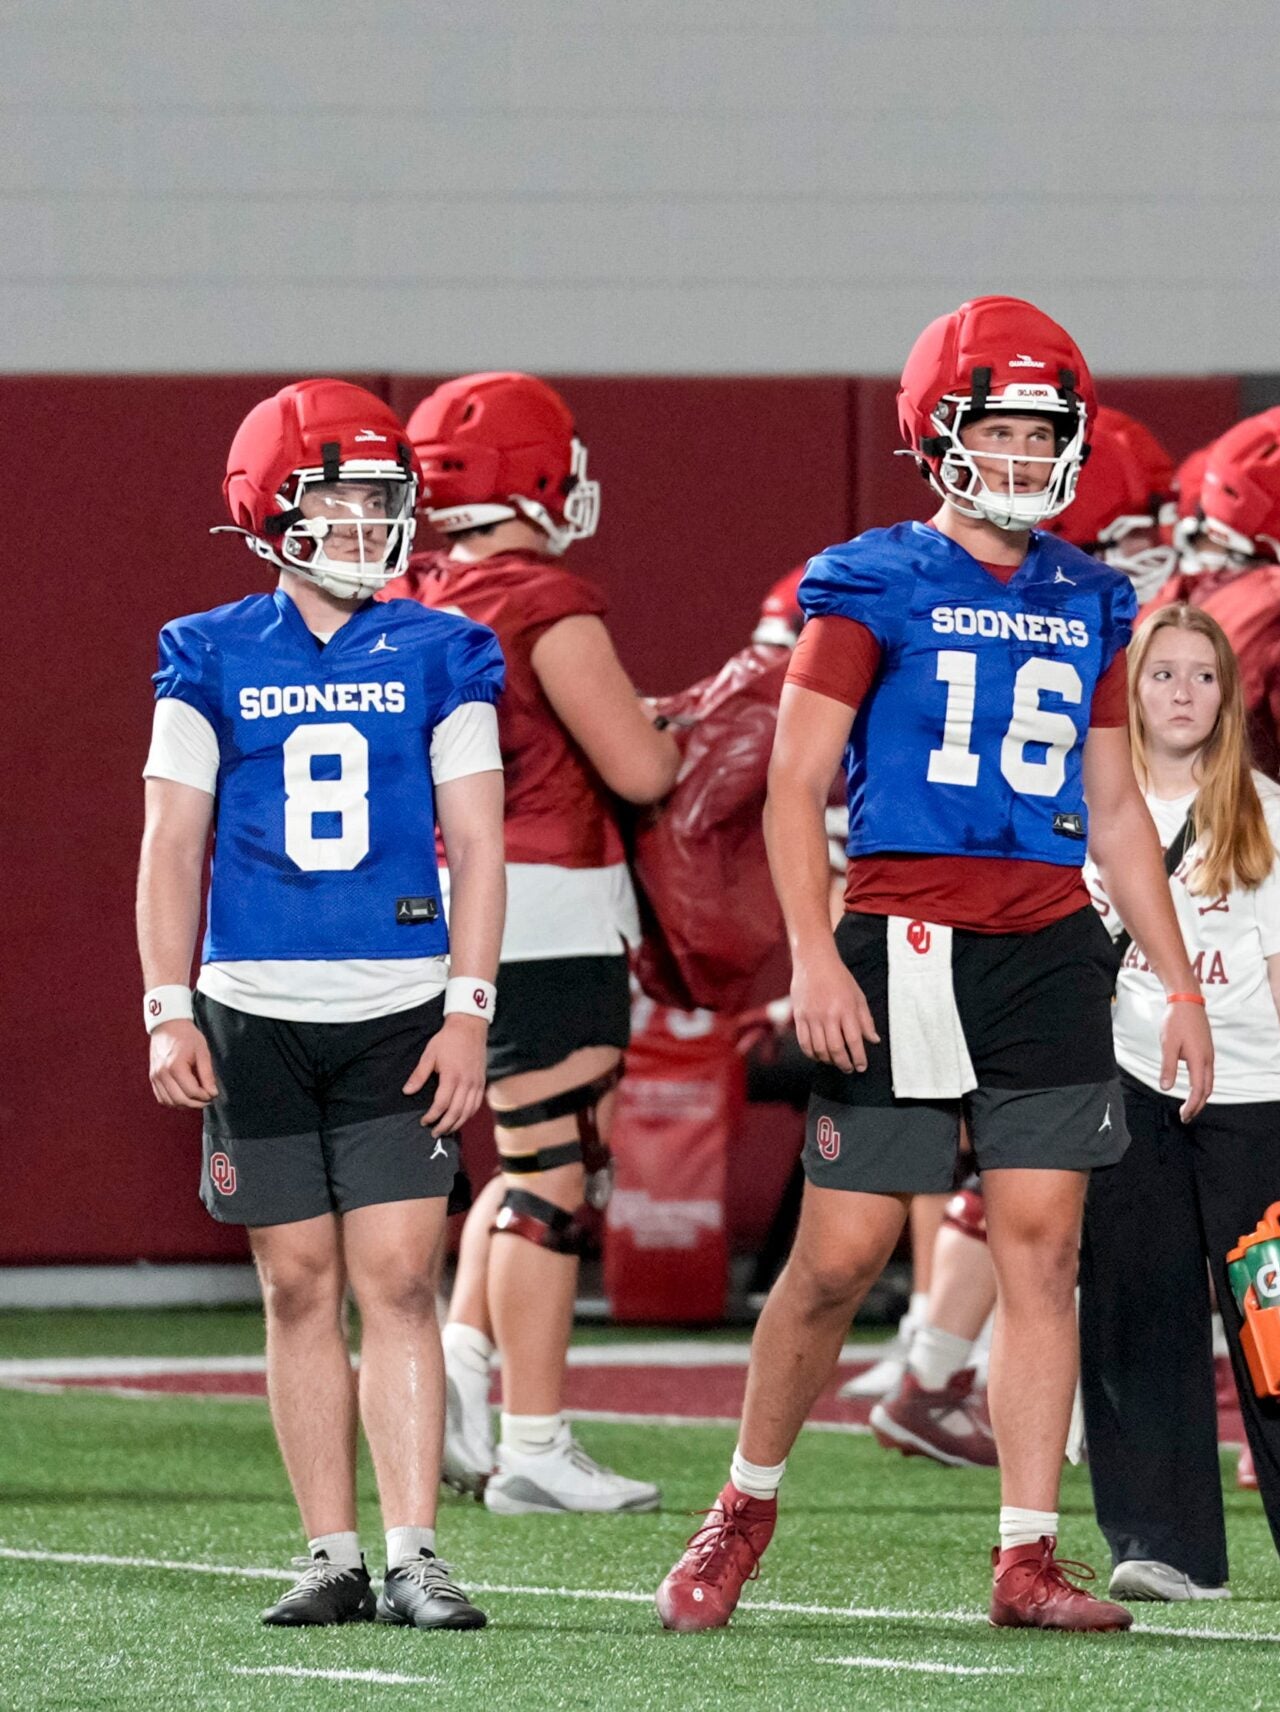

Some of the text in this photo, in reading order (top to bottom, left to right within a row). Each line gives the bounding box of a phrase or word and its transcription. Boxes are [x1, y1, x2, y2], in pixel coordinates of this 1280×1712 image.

[931, 606, 1089, 648] SOONERS
[239, 681, 406, 721] SOONERS
[926, 650, 1083, 798] 16
[283, 722, 370, 872] 8
[906, 919, 931, 955] OU
[472, 988, 488, 1010] OU
[816, 1115, 841, 1160] OU
[210, 1151, 237, 1196] OU
